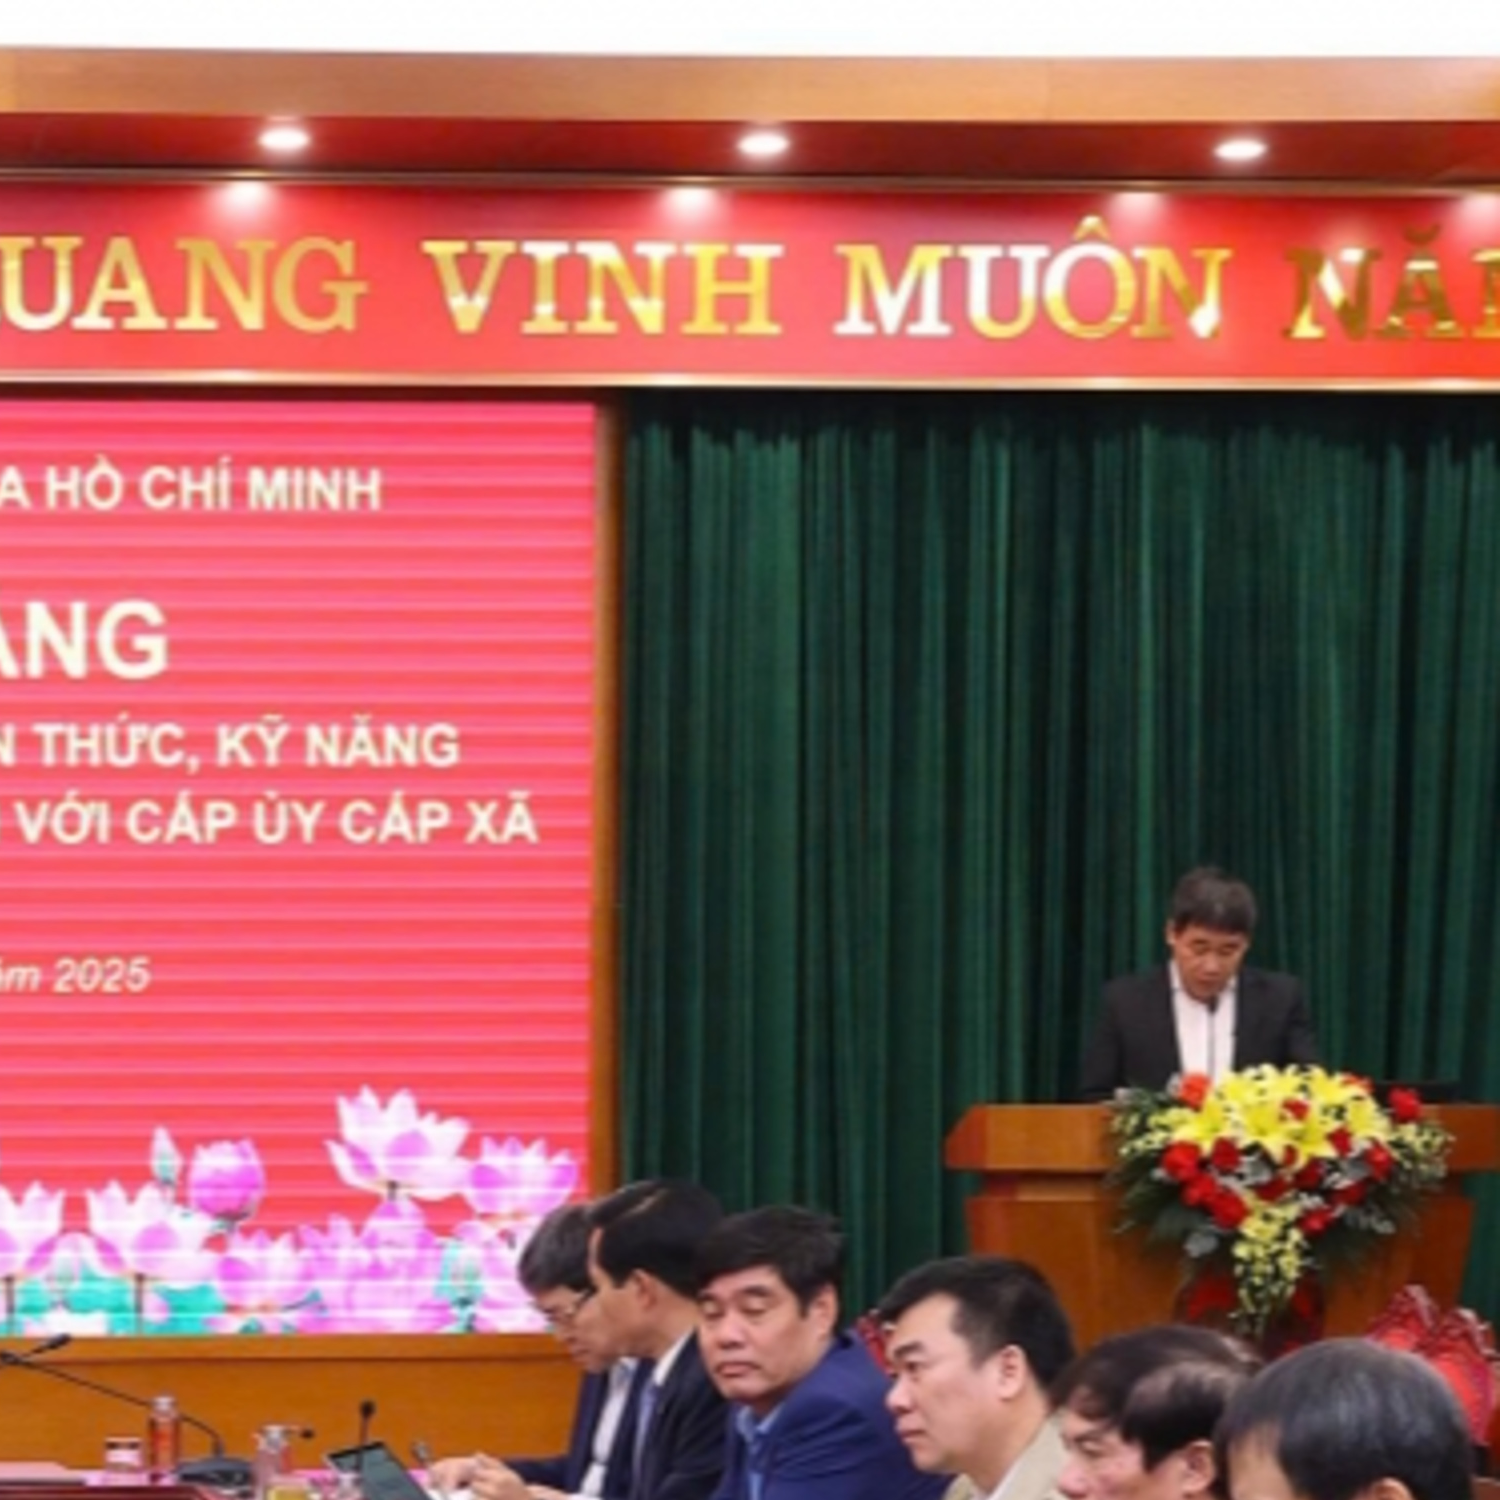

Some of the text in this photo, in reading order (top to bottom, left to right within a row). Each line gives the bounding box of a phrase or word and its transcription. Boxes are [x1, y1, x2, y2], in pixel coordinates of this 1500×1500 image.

[421, 240, 783, 336] VINH
[832, 215, 1233, 340] MUÔN
[1280, 222, 1500, 342] NĂ
[140, 455, 231, 511] CHÍ
[248, 466, 382, 512] MINH
[33, 712, 201, 775] THỨC,
[217, 713, 290, 767] KỸ
[305, 713, 461, 768] NĂNG
[15, 790, 110, 845] VỚI
[252, 790, 326, 844] ỦY
[465, 790, 539, 844] XÃ
[53, 956, 152, 994] 2025
